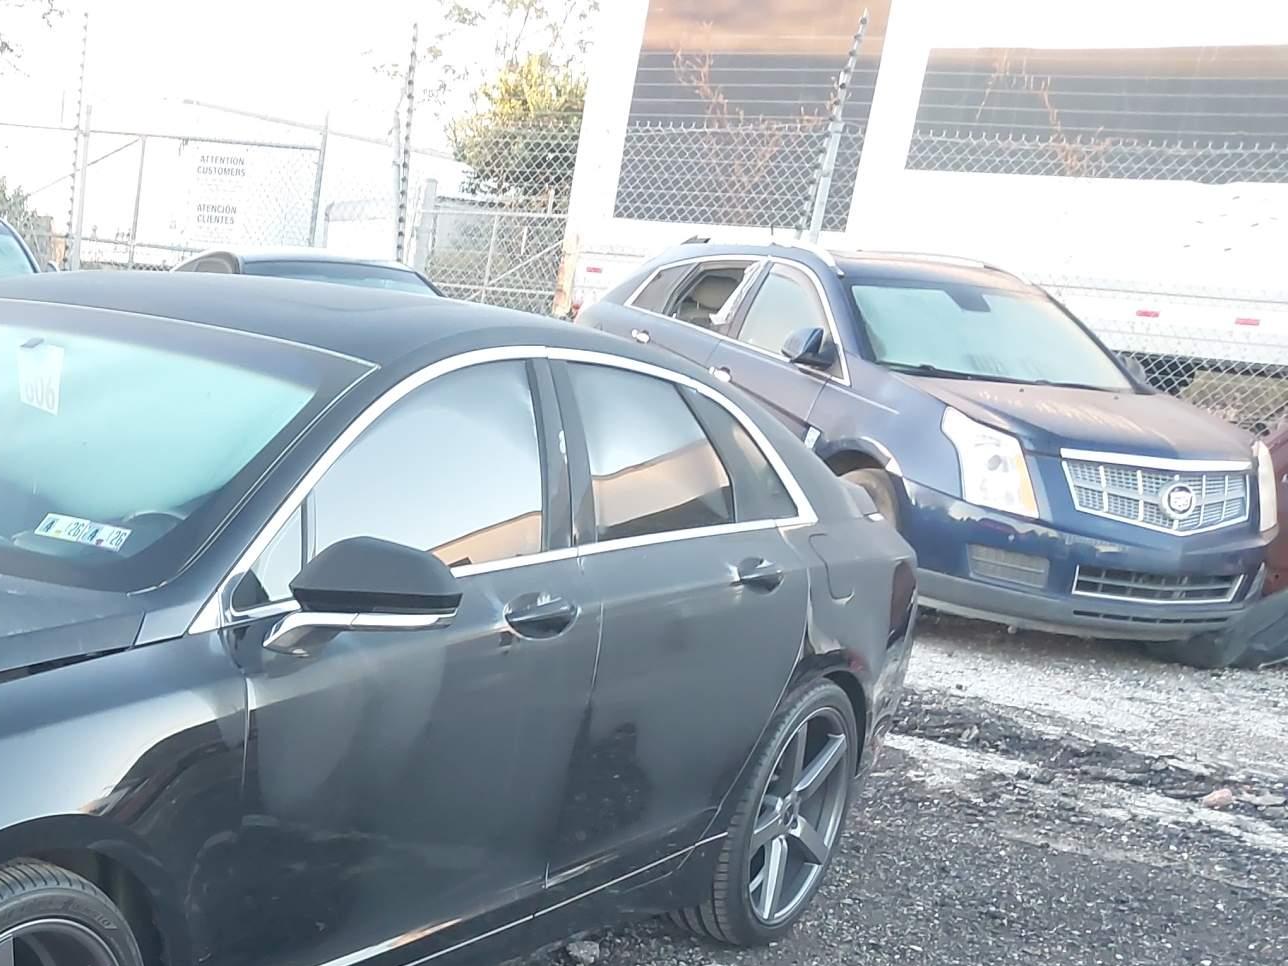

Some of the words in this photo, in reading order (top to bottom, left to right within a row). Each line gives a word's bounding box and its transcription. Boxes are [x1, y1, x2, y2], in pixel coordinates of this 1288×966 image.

[200, 155, 245, 166] ATTENTION
[196, 166, 246, 177] CUSTOMERS
[196, 214, 235, 224] CLIENTES
